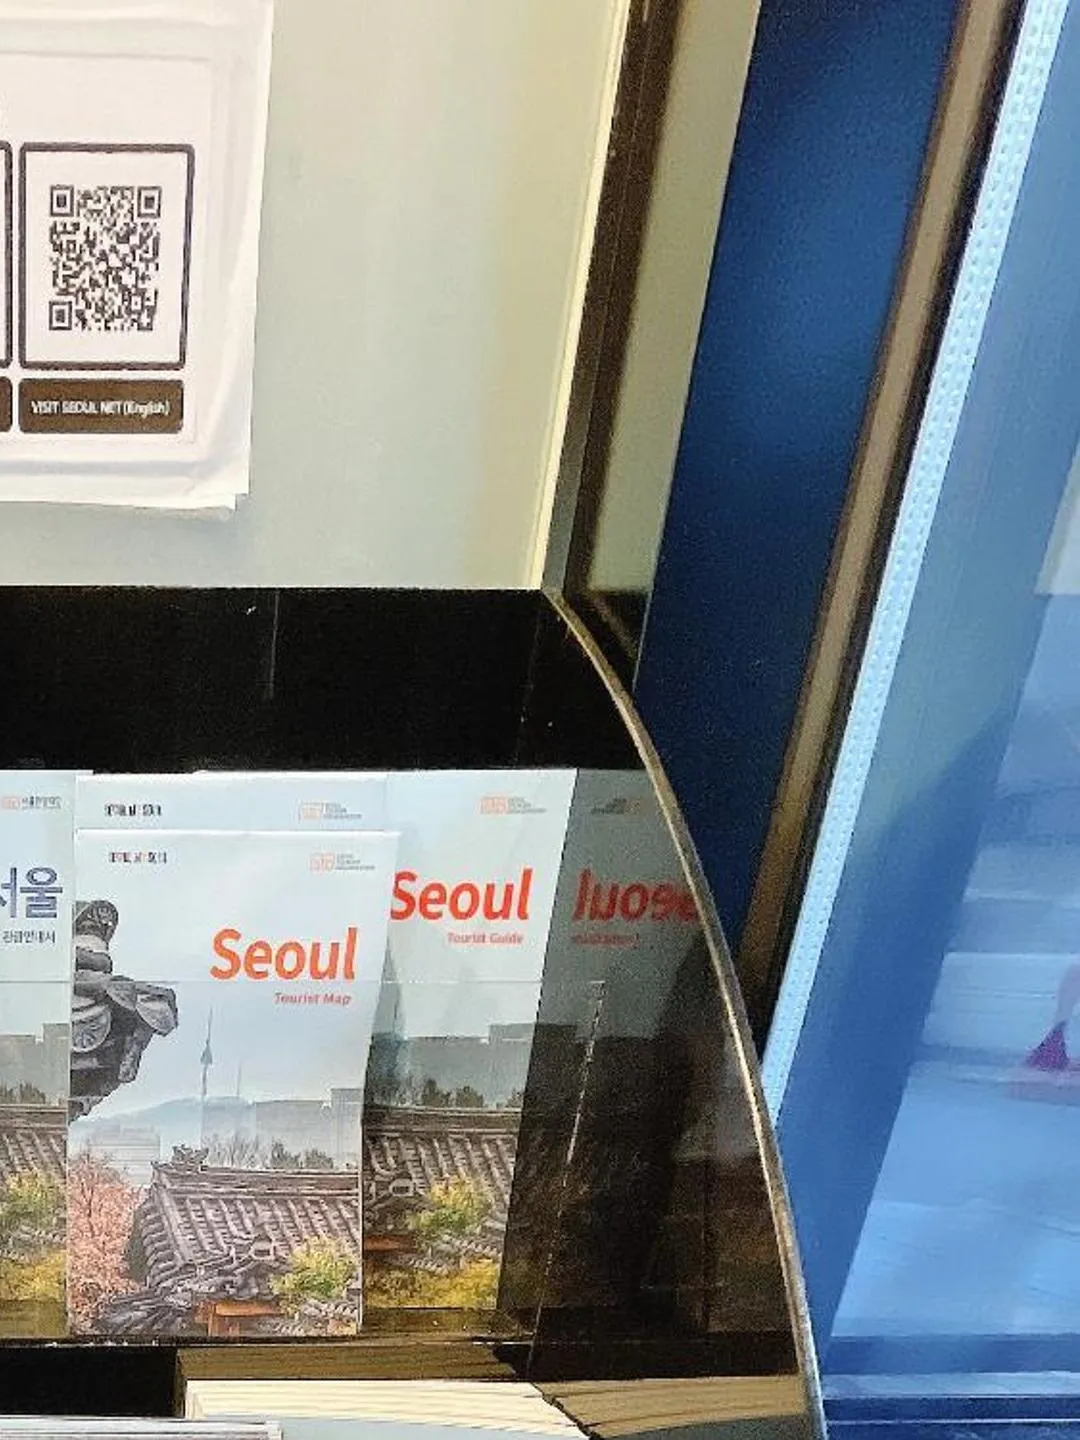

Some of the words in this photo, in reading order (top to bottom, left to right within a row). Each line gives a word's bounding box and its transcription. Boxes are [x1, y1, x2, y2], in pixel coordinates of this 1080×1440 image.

[31, 400, 59, 414] VISIT
[61, 400, 100, 414] SEOUL
[390, 868, 534, 922] Seoul
[447, 931, 486, 944] Tourist
[489, 931, 525, 944] Guide
[209, 926, 358, 981] Seoul
[274, 992, 320, 1005] Tourist
[323, 993, 352, 1007] Map
